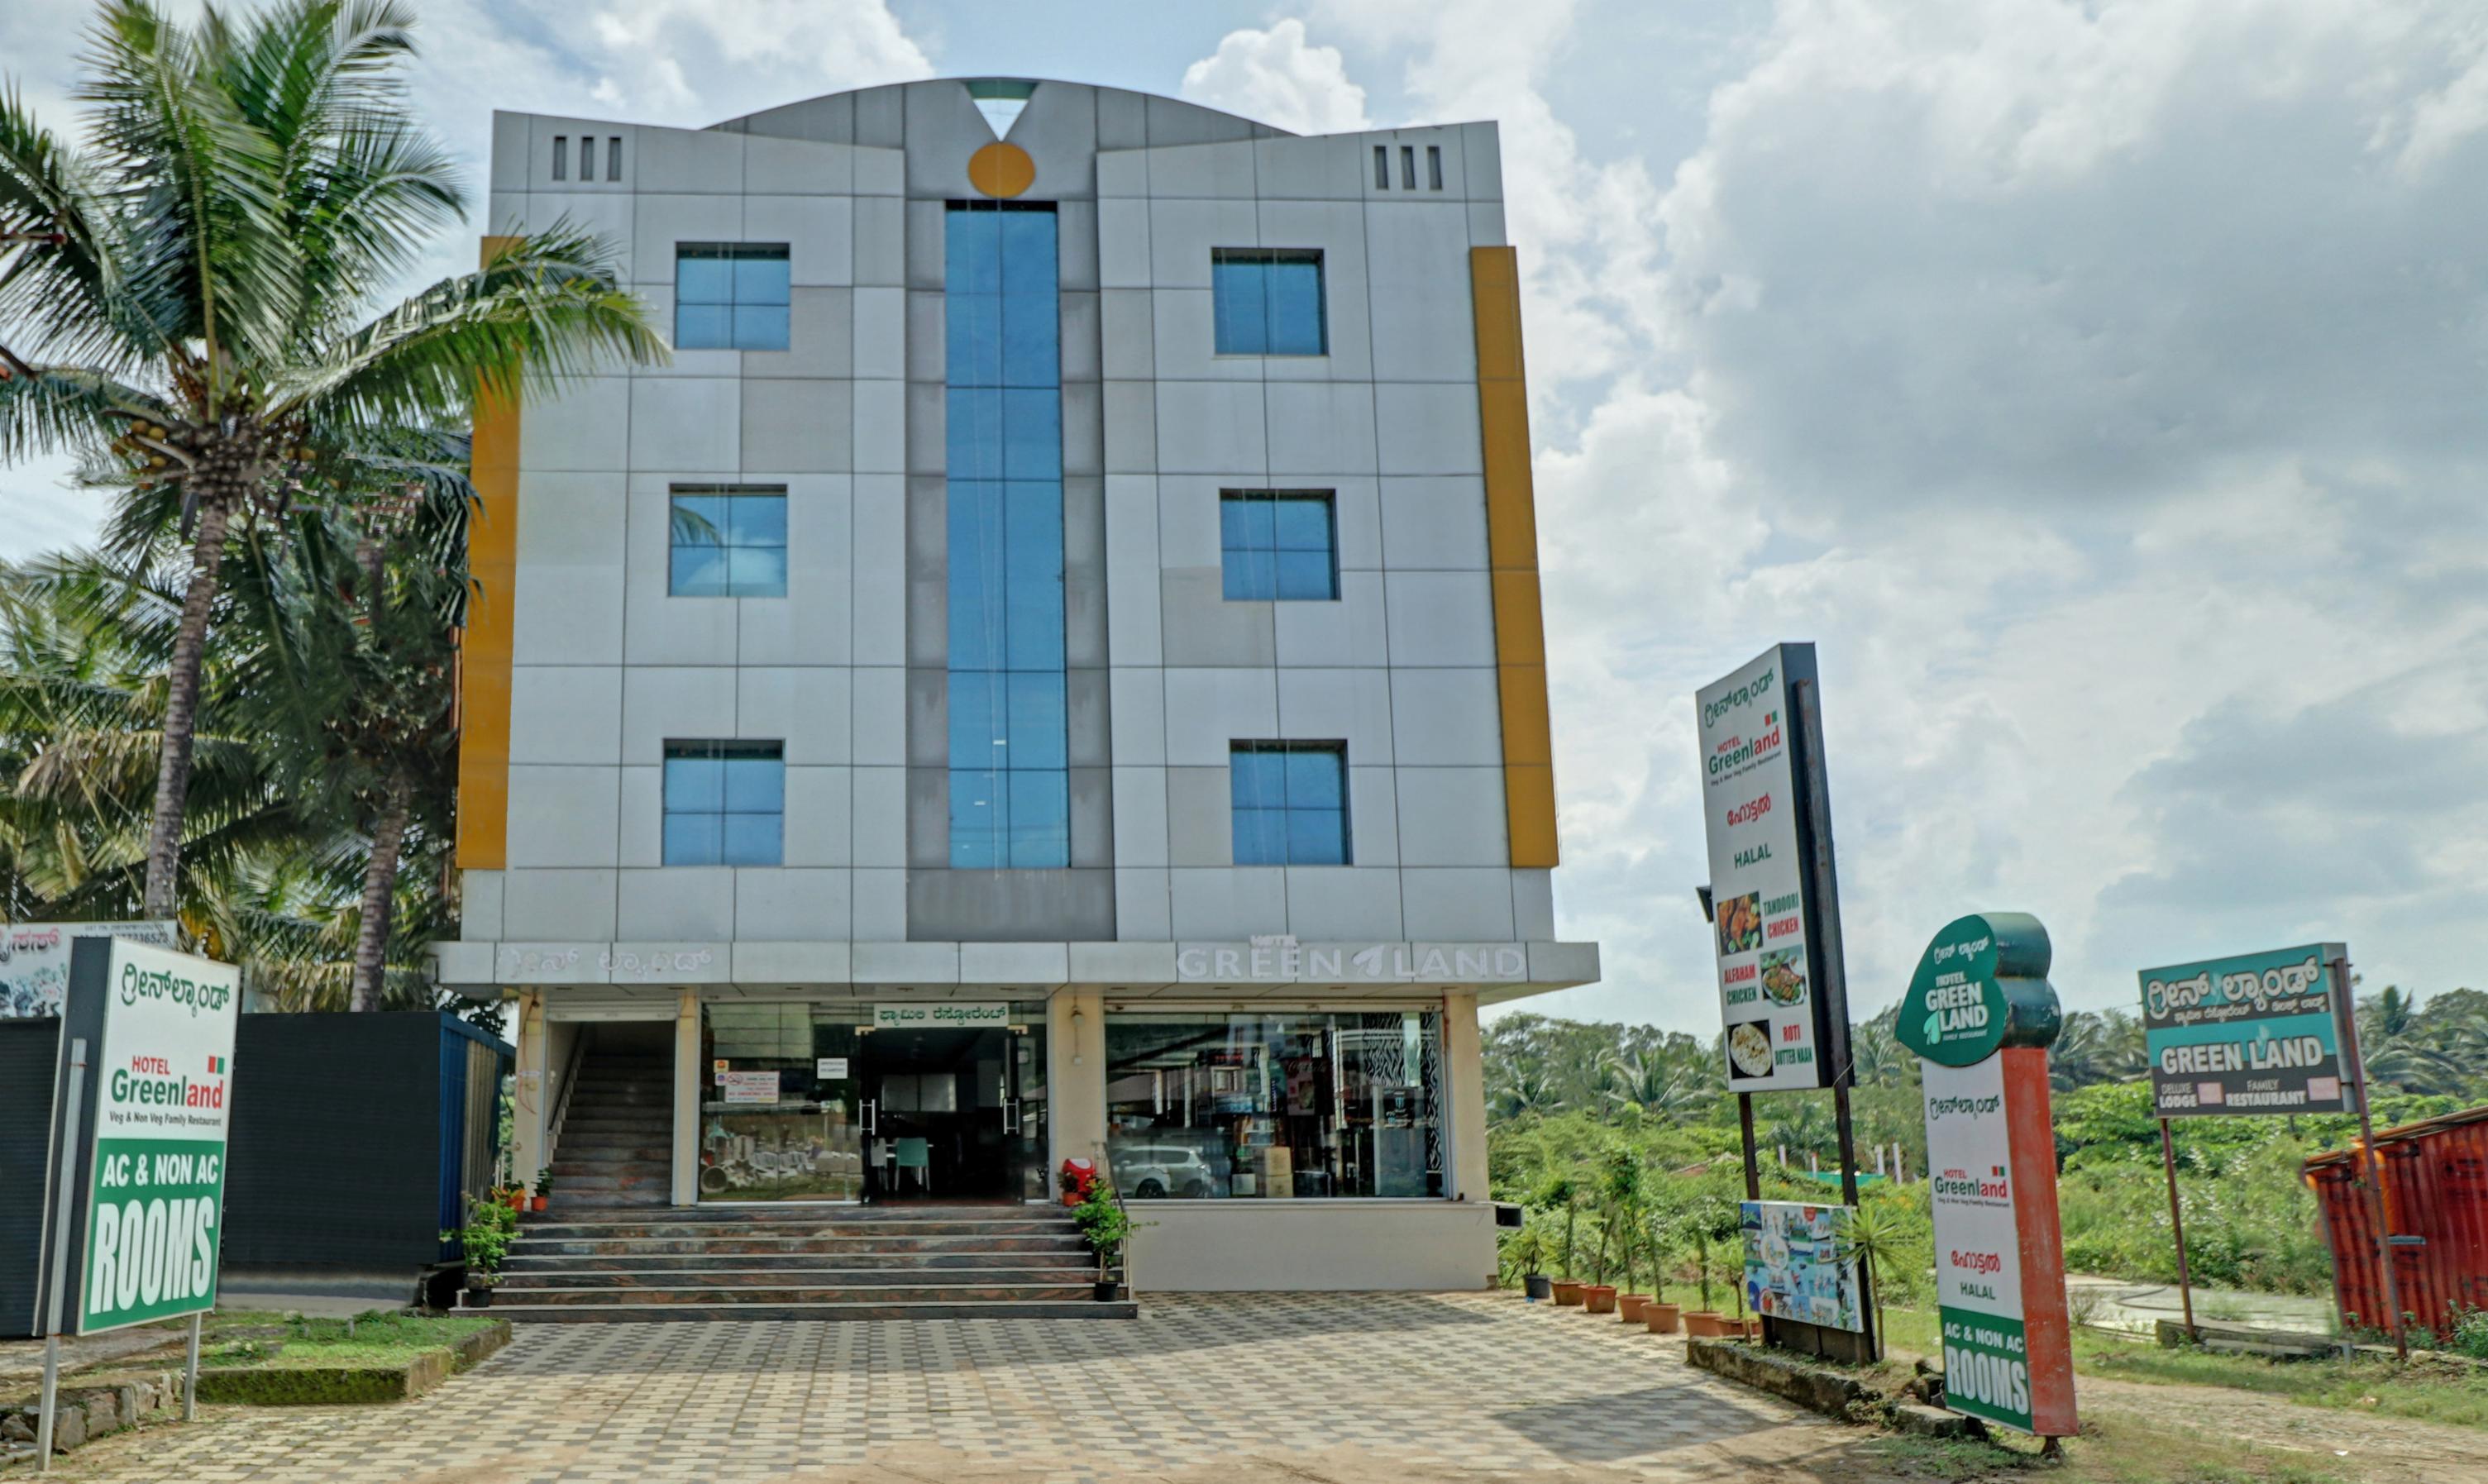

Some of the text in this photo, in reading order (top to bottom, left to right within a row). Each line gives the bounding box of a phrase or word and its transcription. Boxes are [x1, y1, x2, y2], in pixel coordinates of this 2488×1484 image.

[1708, 725, 1779, 775] Greenland
[1717, 736, 1741, 754] HOTEL
[1727, 792, 1771, 826] ഹോട്ടൽ
[1734, 843, 1772, 869] HALAL
[1763, 892, 1799, 916] TANDOORI
[1767, 917, 1799, 939] CHICKEN
[1177, 948, 1529, 978] GREEN LAND
[1724, 965, 1756, 984] ALFAHAM
[1936, 971, 1966, 987] HOTEL
[2147, 957, 2318, 1020] ಗ್ರೀನ್ ಲ್ಯಾಂಡ್
[1726, 986, 1757, 1005] CHICKEN
[1925, 981, 1983, 1012] GREEN
[1939, 1004, 1988, 1033] LAND
[1783, 1024, 1800, 1042] ROTI
[132, 1056, 170, 1075] HOTEL
[1774, 1047, 1812, 1066] BUTTER NAAN
[2161, 1037, 2323, 1075] GREEN LAND
[111, 1068, 223, 1109] Greenland
[2247, 1079, 2280, 1091] FAMILY
[2159, 1095, 2199, 1109] LODGE
[2226, 1090, 2307, 1107] RESTAURANT
[109, 1111, 222, 1127] Veg & Non Veg Family Restaurant
[101, 1153, 219, 1187] AC & NON AC
[1944, 1168, 1967, 1179] HOTEL
[1935, 1176, 2008, 1198] Greenland
[89, 1195, 215, 1315] ROOMS
[1951, 1250, 2001, 1274] ഹോട്ടൽ
[1960, 1281, 1996, 1300] HALAL
[1945, 1322, 2024, 1353] AC & NON AC
[1945, 1344, 2029, 1415] ROOMS
